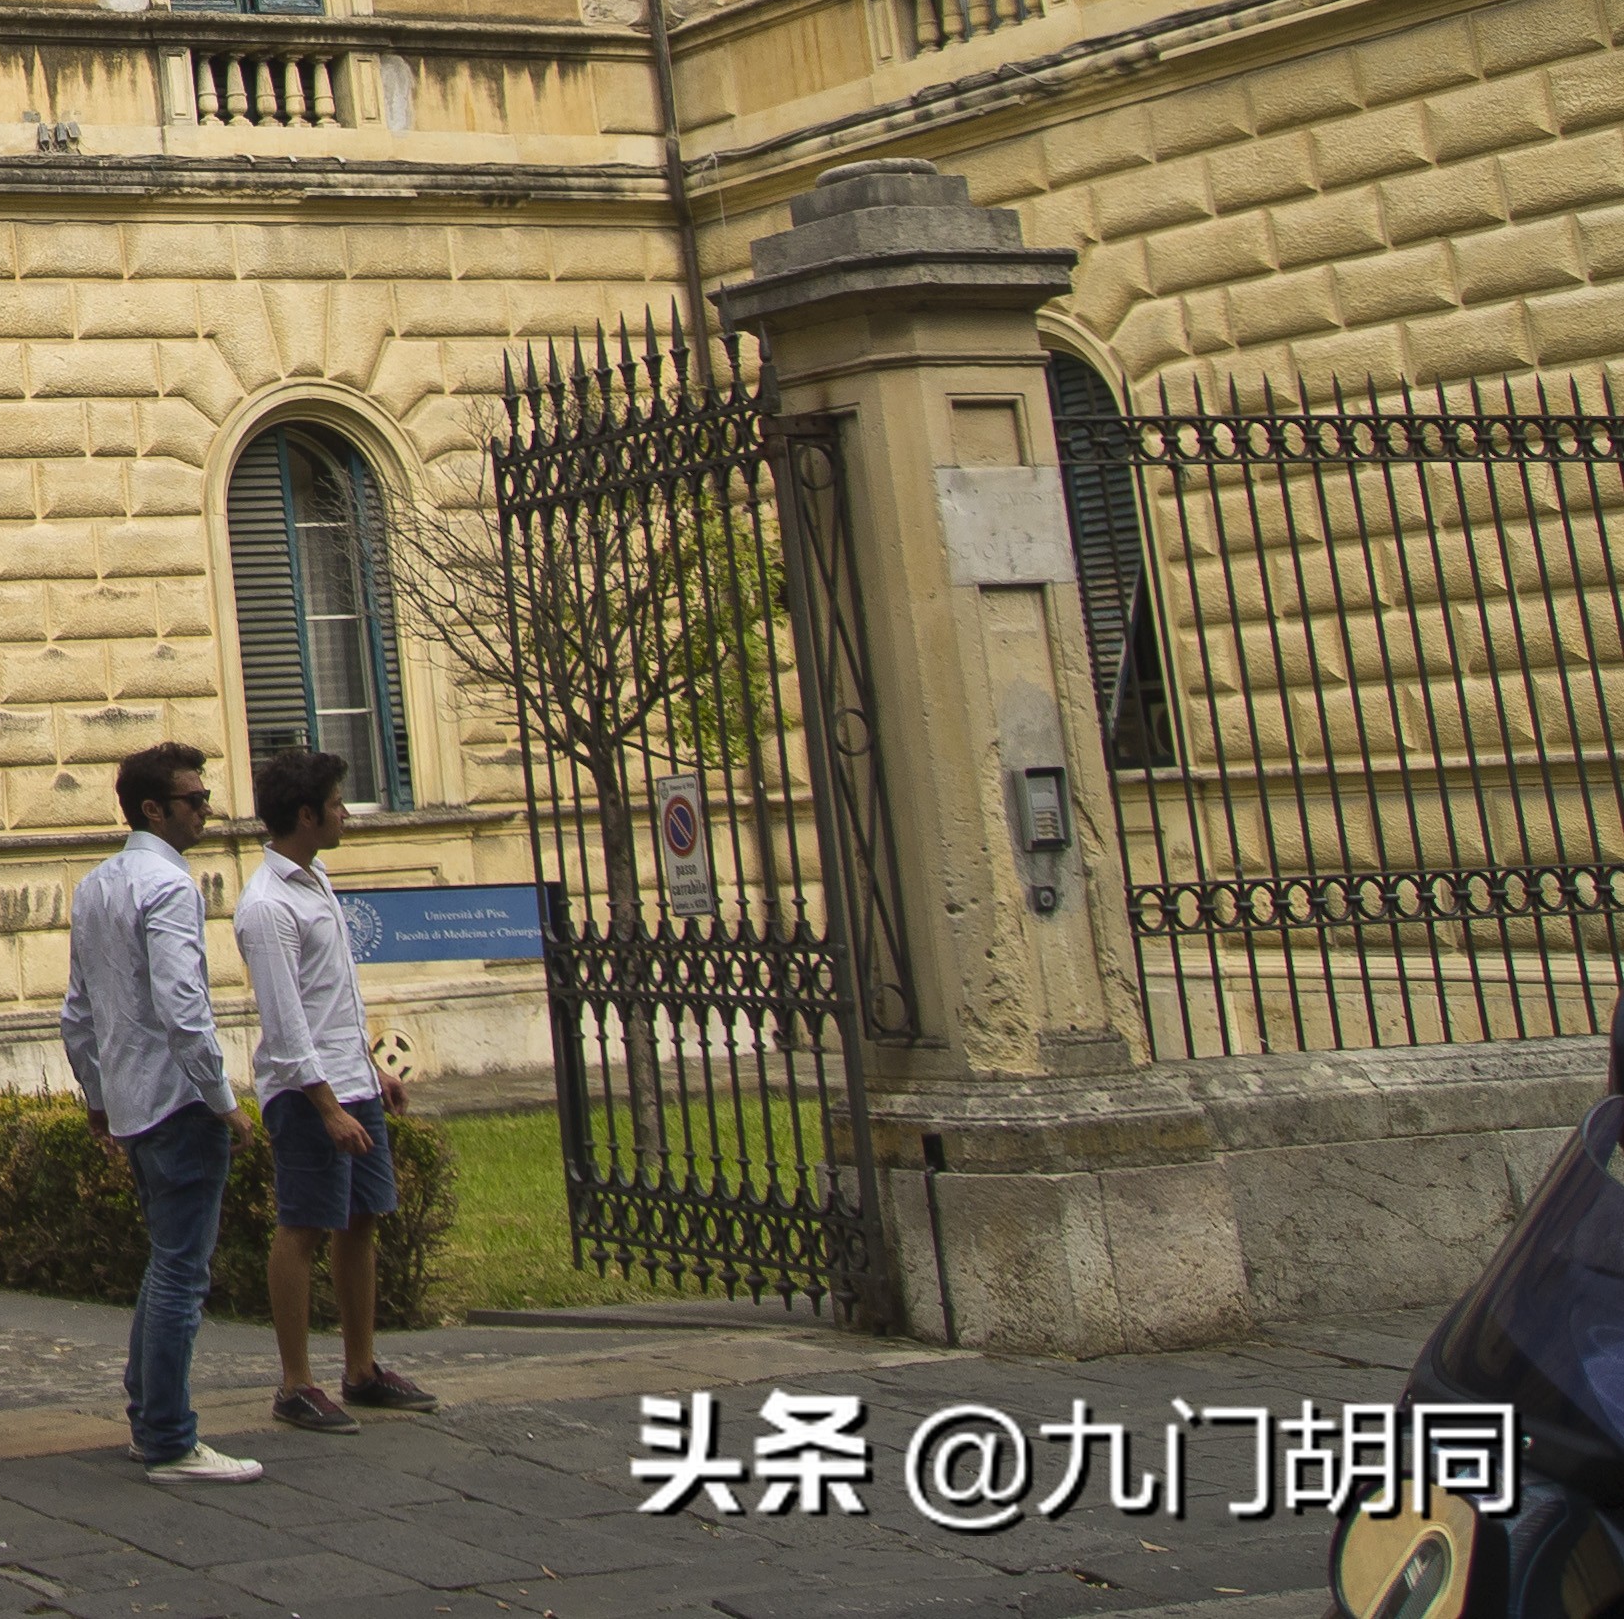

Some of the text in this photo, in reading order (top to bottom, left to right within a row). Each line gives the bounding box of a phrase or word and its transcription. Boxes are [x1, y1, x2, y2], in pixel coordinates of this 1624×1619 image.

[675, 864, 697, 879] passo
[671, 879, 707, 895] carrabile
[424, 909, 472, 921] Università
[474, 909, 484, 919] di
[395, 930, 431, 941] Facoltà
[432, 930, 442, 940] di
[443, 929, 488, 940] Medicina
[496, 927, 542, 938] Chirurgia
